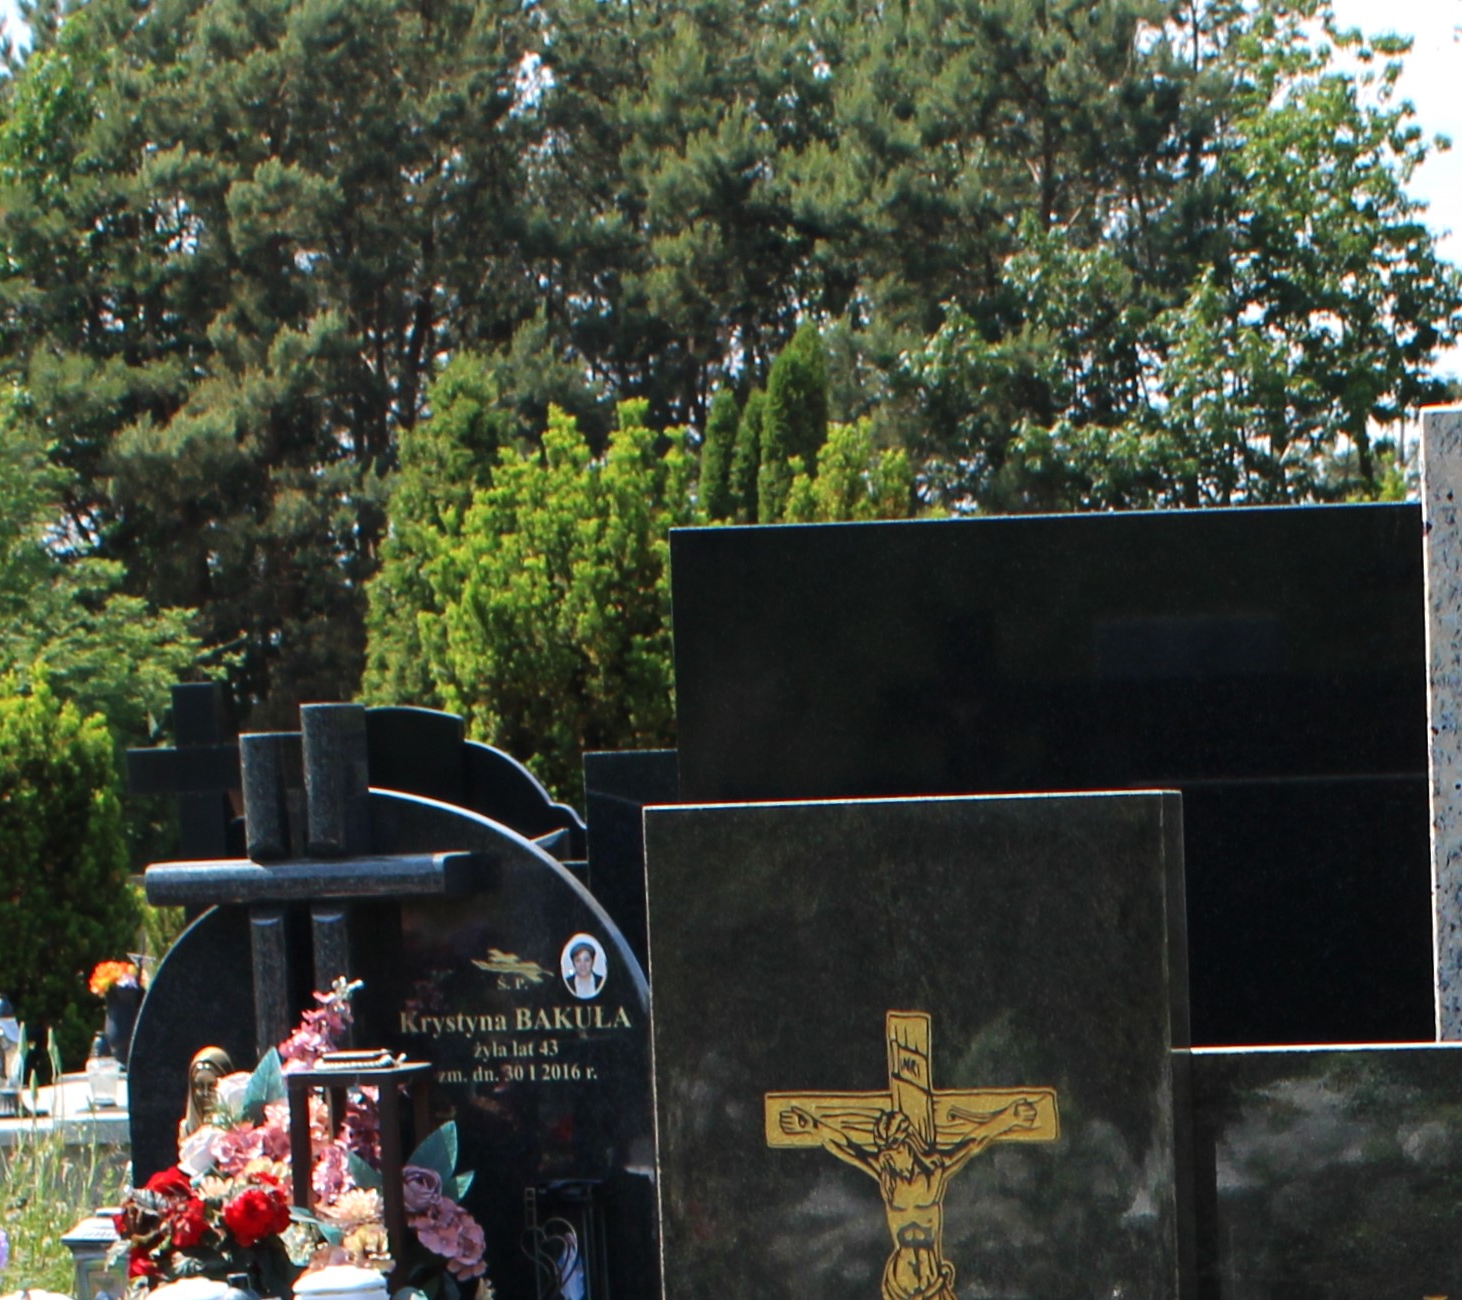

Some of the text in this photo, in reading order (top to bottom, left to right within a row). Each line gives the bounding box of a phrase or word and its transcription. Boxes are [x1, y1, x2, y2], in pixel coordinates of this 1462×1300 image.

[399, 1004, 632, 1038] Krystyna BAKUŁA
[512, 1039, 534, 1058] lat
[539, 1038, 560, 1057] 43
[438, 1067, 468, 1084] zm.
[473, 1064, 499, 1083] dn.
[504, 1063, 524, 1082] 30
[542, 1062, 581, 1081] 2016
